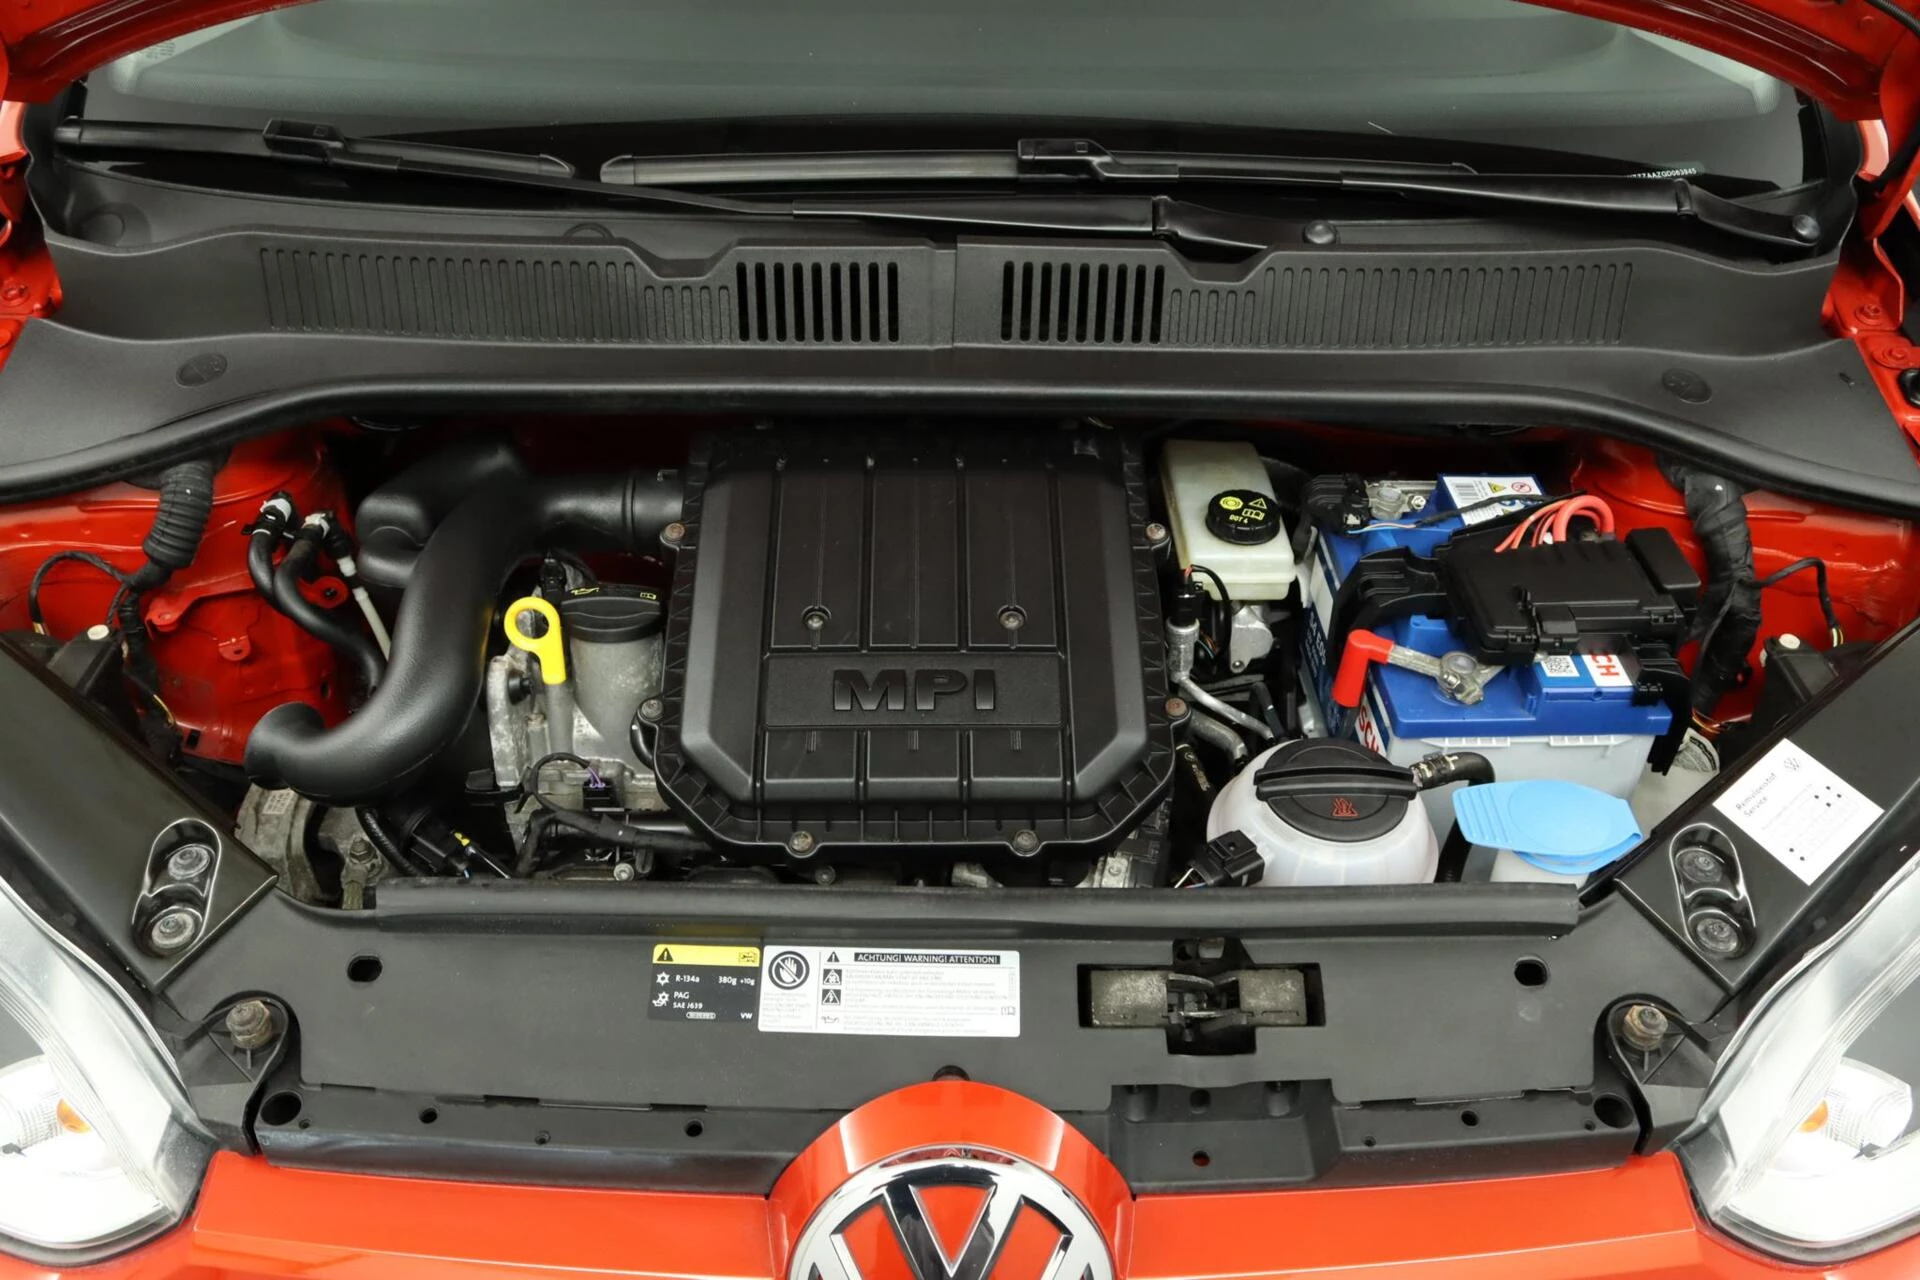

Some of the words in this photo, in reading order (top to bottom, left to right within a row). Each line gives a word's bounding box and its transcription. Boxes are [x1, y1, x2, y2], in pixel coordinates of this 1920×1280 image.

[833, 668, 996, 711] MPI
[858, 953, 901, 962] ACHTUNG!
[903, 954, 948, 963] WARNING!
[950, 955, 998, 964] ATTENTION!
[675, 975, 700, 983] R-134a
[718, 976, 738, 986] 380g
